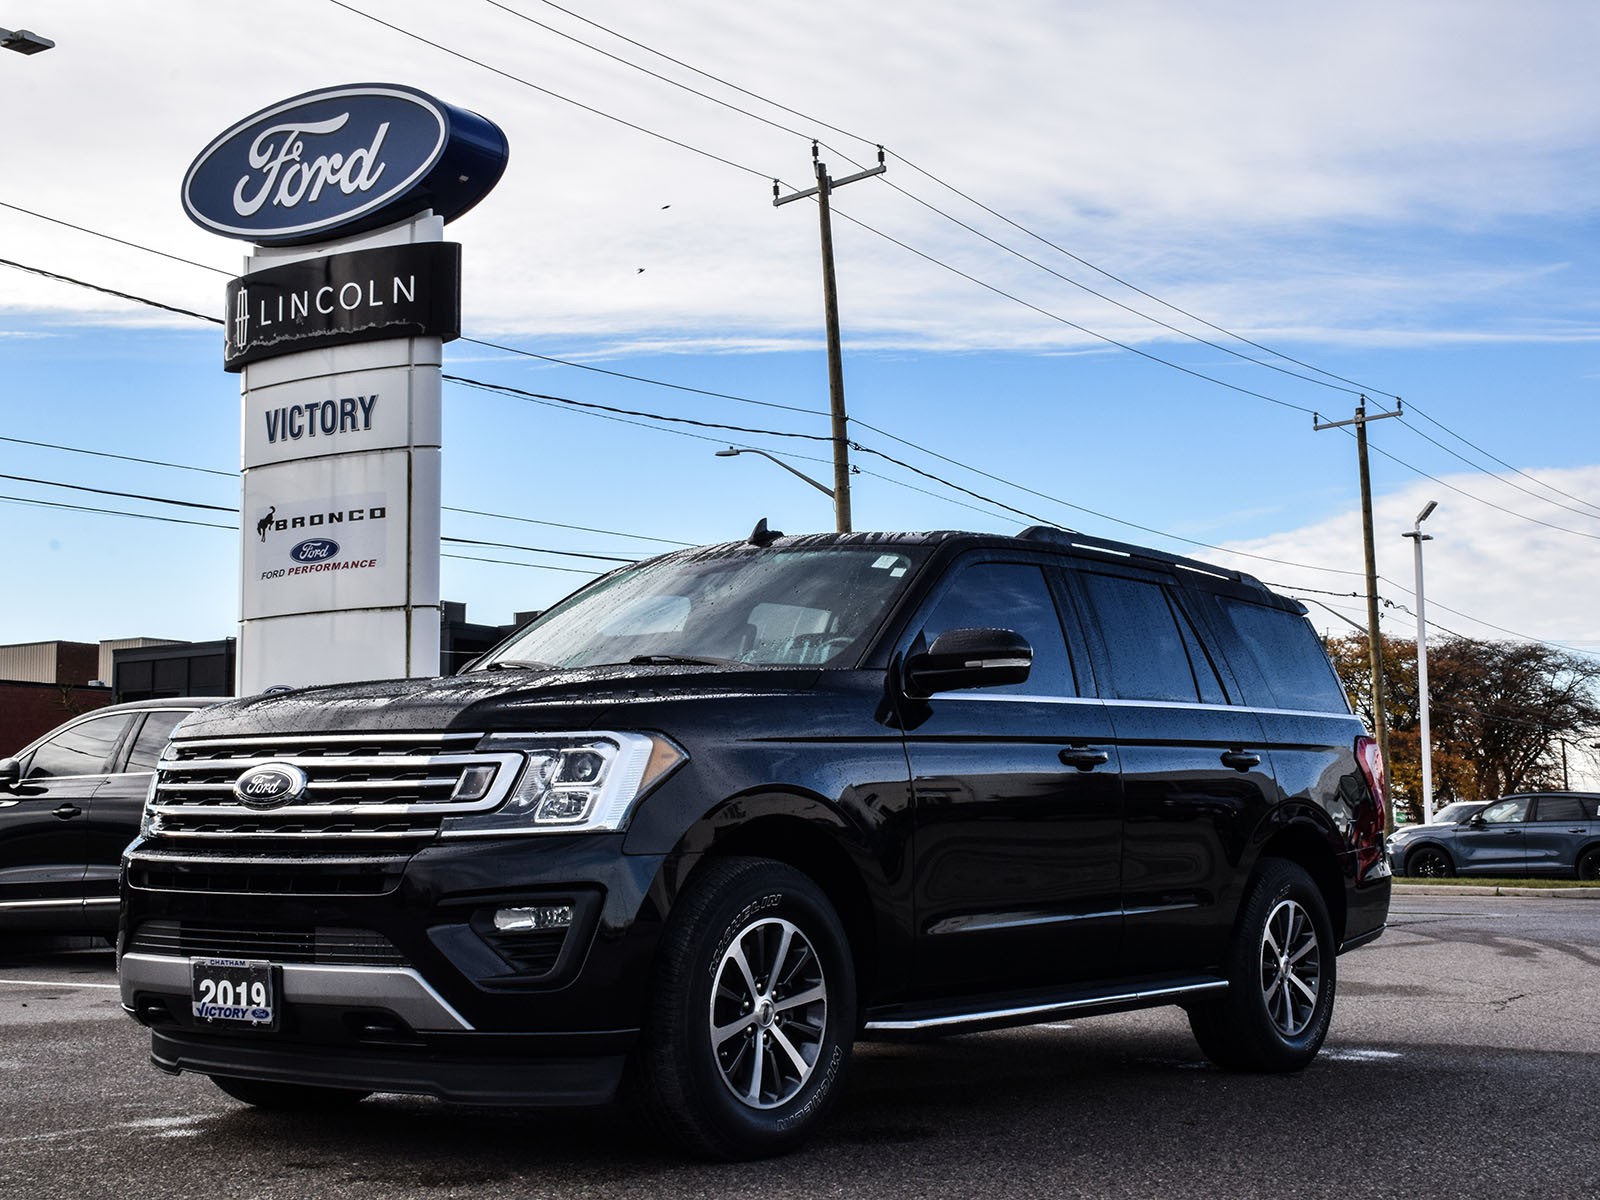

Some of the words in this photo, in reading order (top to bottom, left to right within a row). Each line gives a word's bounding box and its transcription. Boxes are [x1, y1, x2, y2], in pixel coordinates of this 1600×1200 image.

[232, 111, 390, 217] Ford
[259, 275, 416, 326] LINCOLN
[265, 394, 380, 444] VICTORY
[274, 506, 387, 532] BRONCO
[299, 541, 330, 560] Ford
[260, 568, 286, 580] FORD
[287, 558, 377, 576] PERFORMANCE
[246, 774, 282, 794] Ford
[210, 959, 246, 967] CHATHAM
[199, 978, 267, 1008] 2019
[195, 1001, 249, 1019] VICTORY
